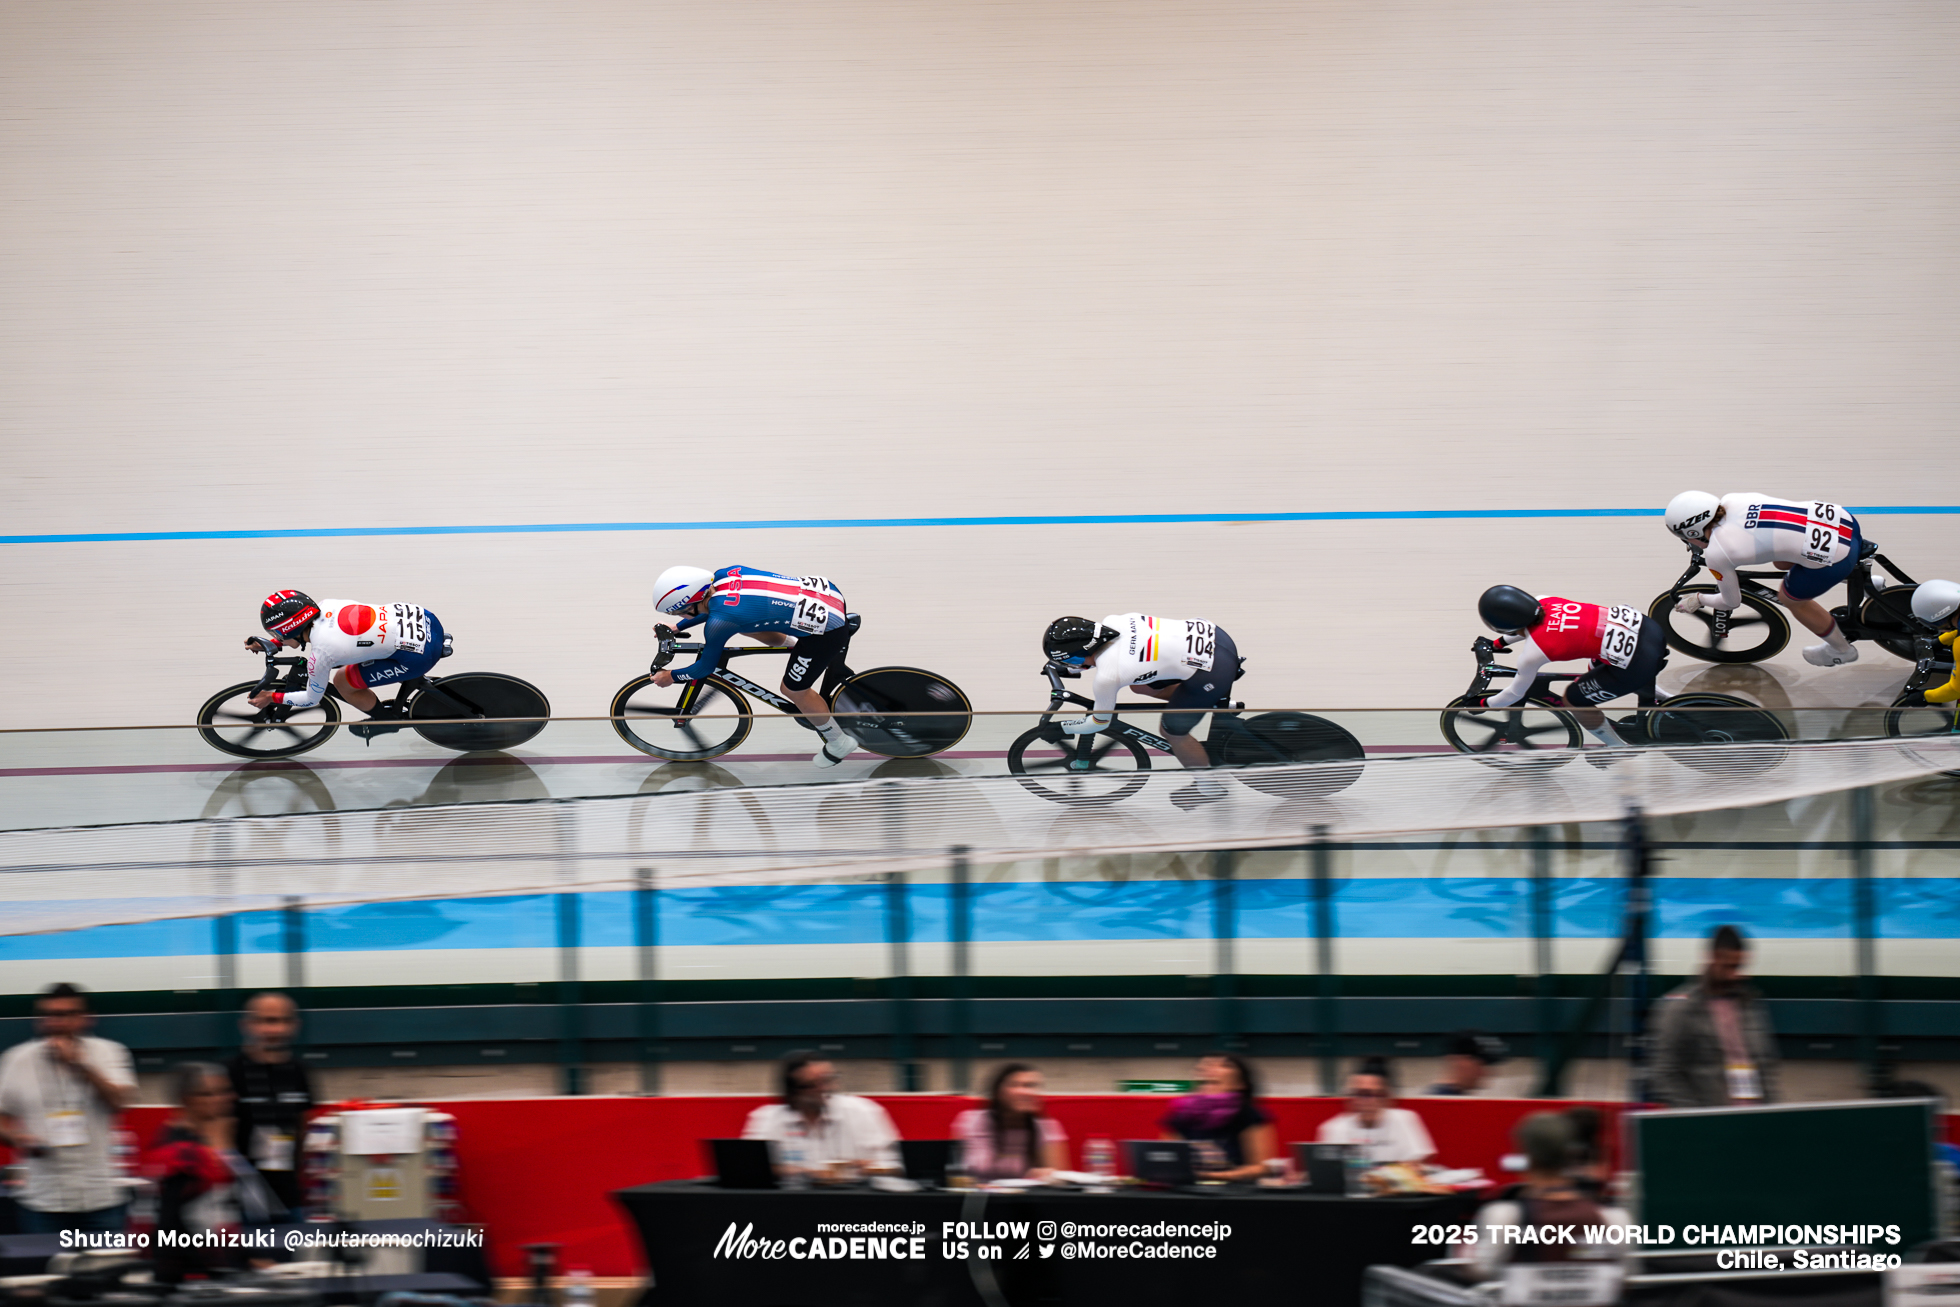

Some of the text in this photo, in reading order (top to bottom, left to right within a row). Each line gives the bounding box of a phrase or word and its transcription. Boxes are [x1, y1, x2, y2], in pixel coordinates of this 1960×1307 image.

[1673, 509, 1711, 532] LAZER
[1744, 504, 1761, 530] GBR
[1810, 527, 1832, 553] 92
[723, 567, 743, 607] USA
[665, 595, 691, 613] GIRO
[771, 600, 797, 609] HOVE
[798, 598, 827, 624] 143
[265, 611, 284, 624] JAPAN
[281, 609, 314, 633] Kabuto
[377, 606, 388, 644] JAPA
[397, 618, 426, 642] 115
[1546, 603, 1563, 633] TEAM
[1559, 603, 1582, 633] TTO
[1715, 611, 1728, 634] LOTU
[1186, 634, 1214, 659] 104
[1605, 628, 1635, 657] 136
[677, 673, 694, 681] USA
[788, 655, 813, 683] USA
[713, 667, 789, 708] LOOK
[1578, 678, 1602, 695] TEAM
[1123, 728, 1173, 751] FES
